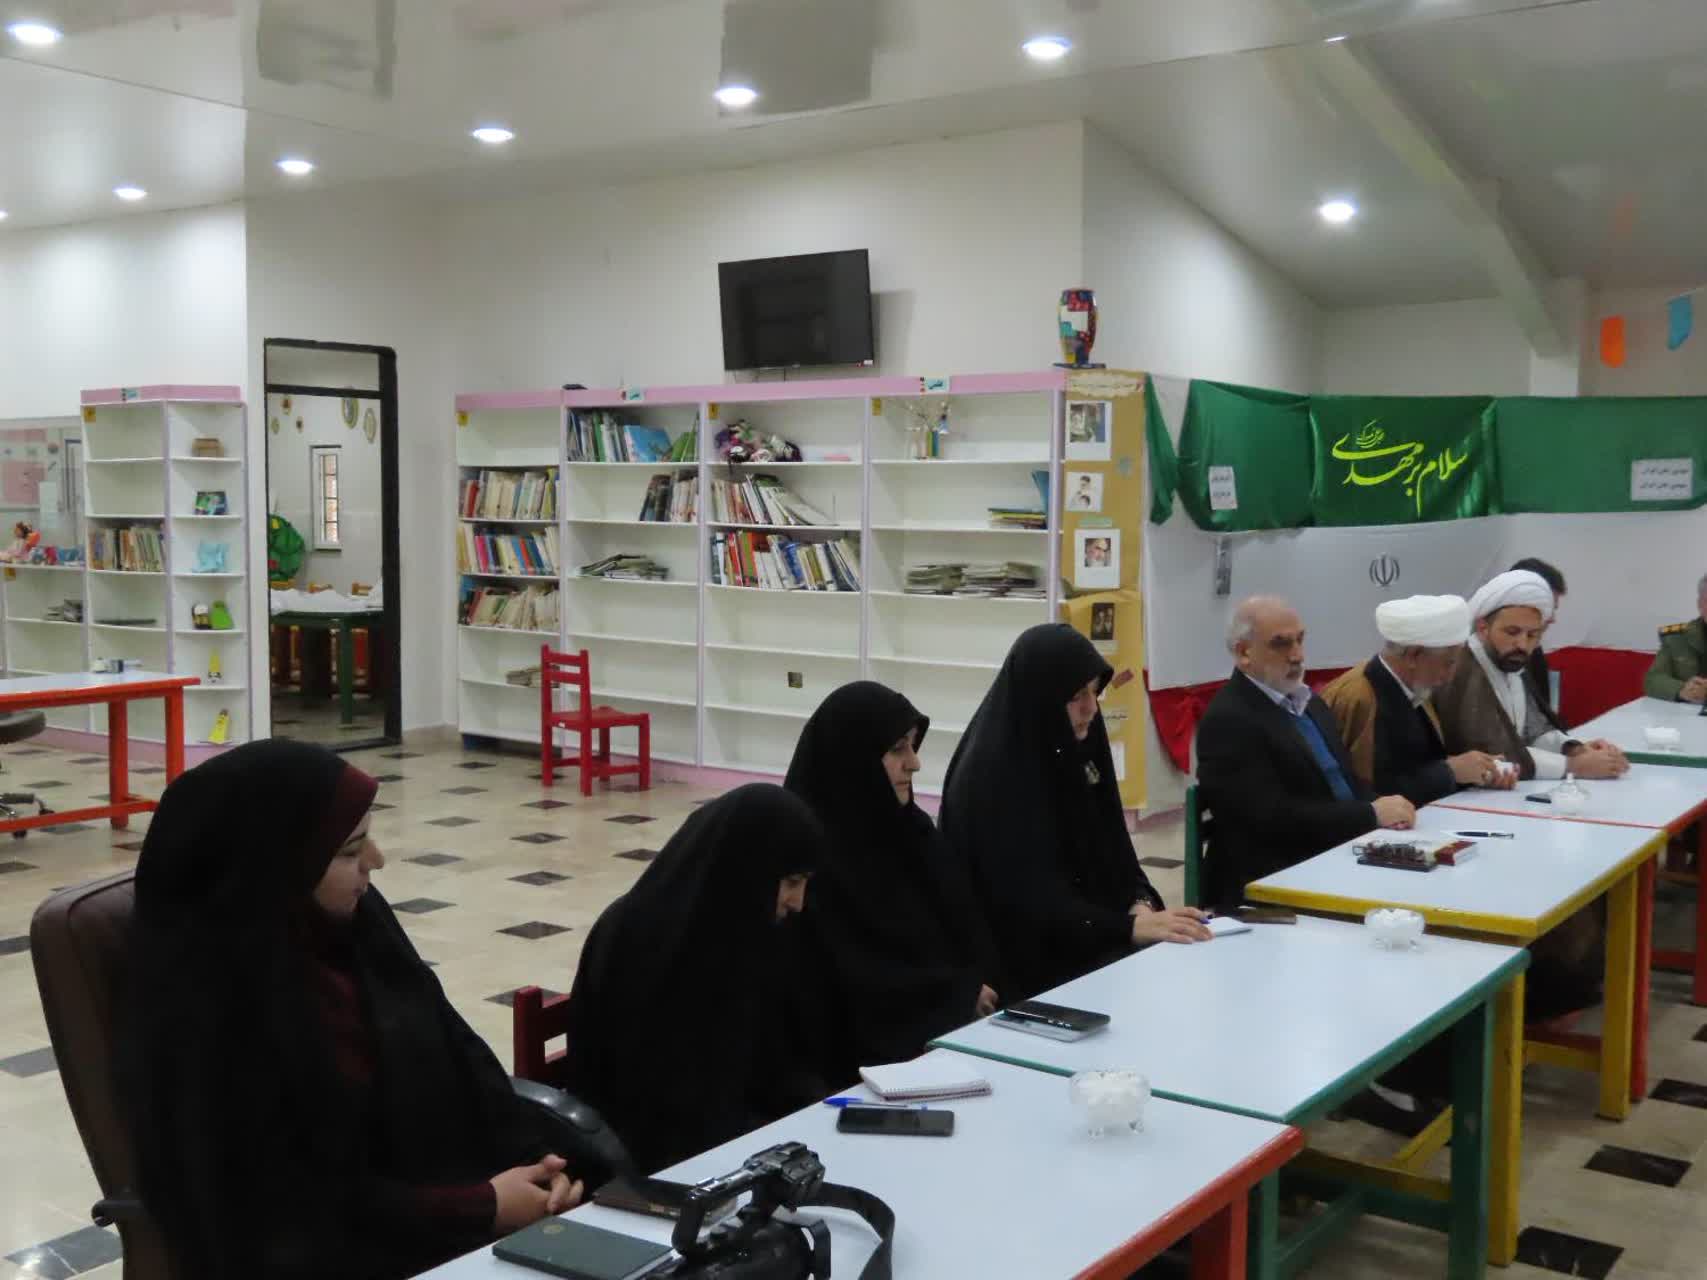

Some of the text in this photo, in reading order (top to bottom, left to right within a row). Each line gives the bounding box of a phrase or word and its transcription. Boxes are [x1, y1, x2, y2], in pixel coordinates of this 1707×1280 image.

[1332, 433, 1424, 487] مهدی
[1402, 461, 1423, 497] بر
[1416, 447, 1468, 518] سلام
